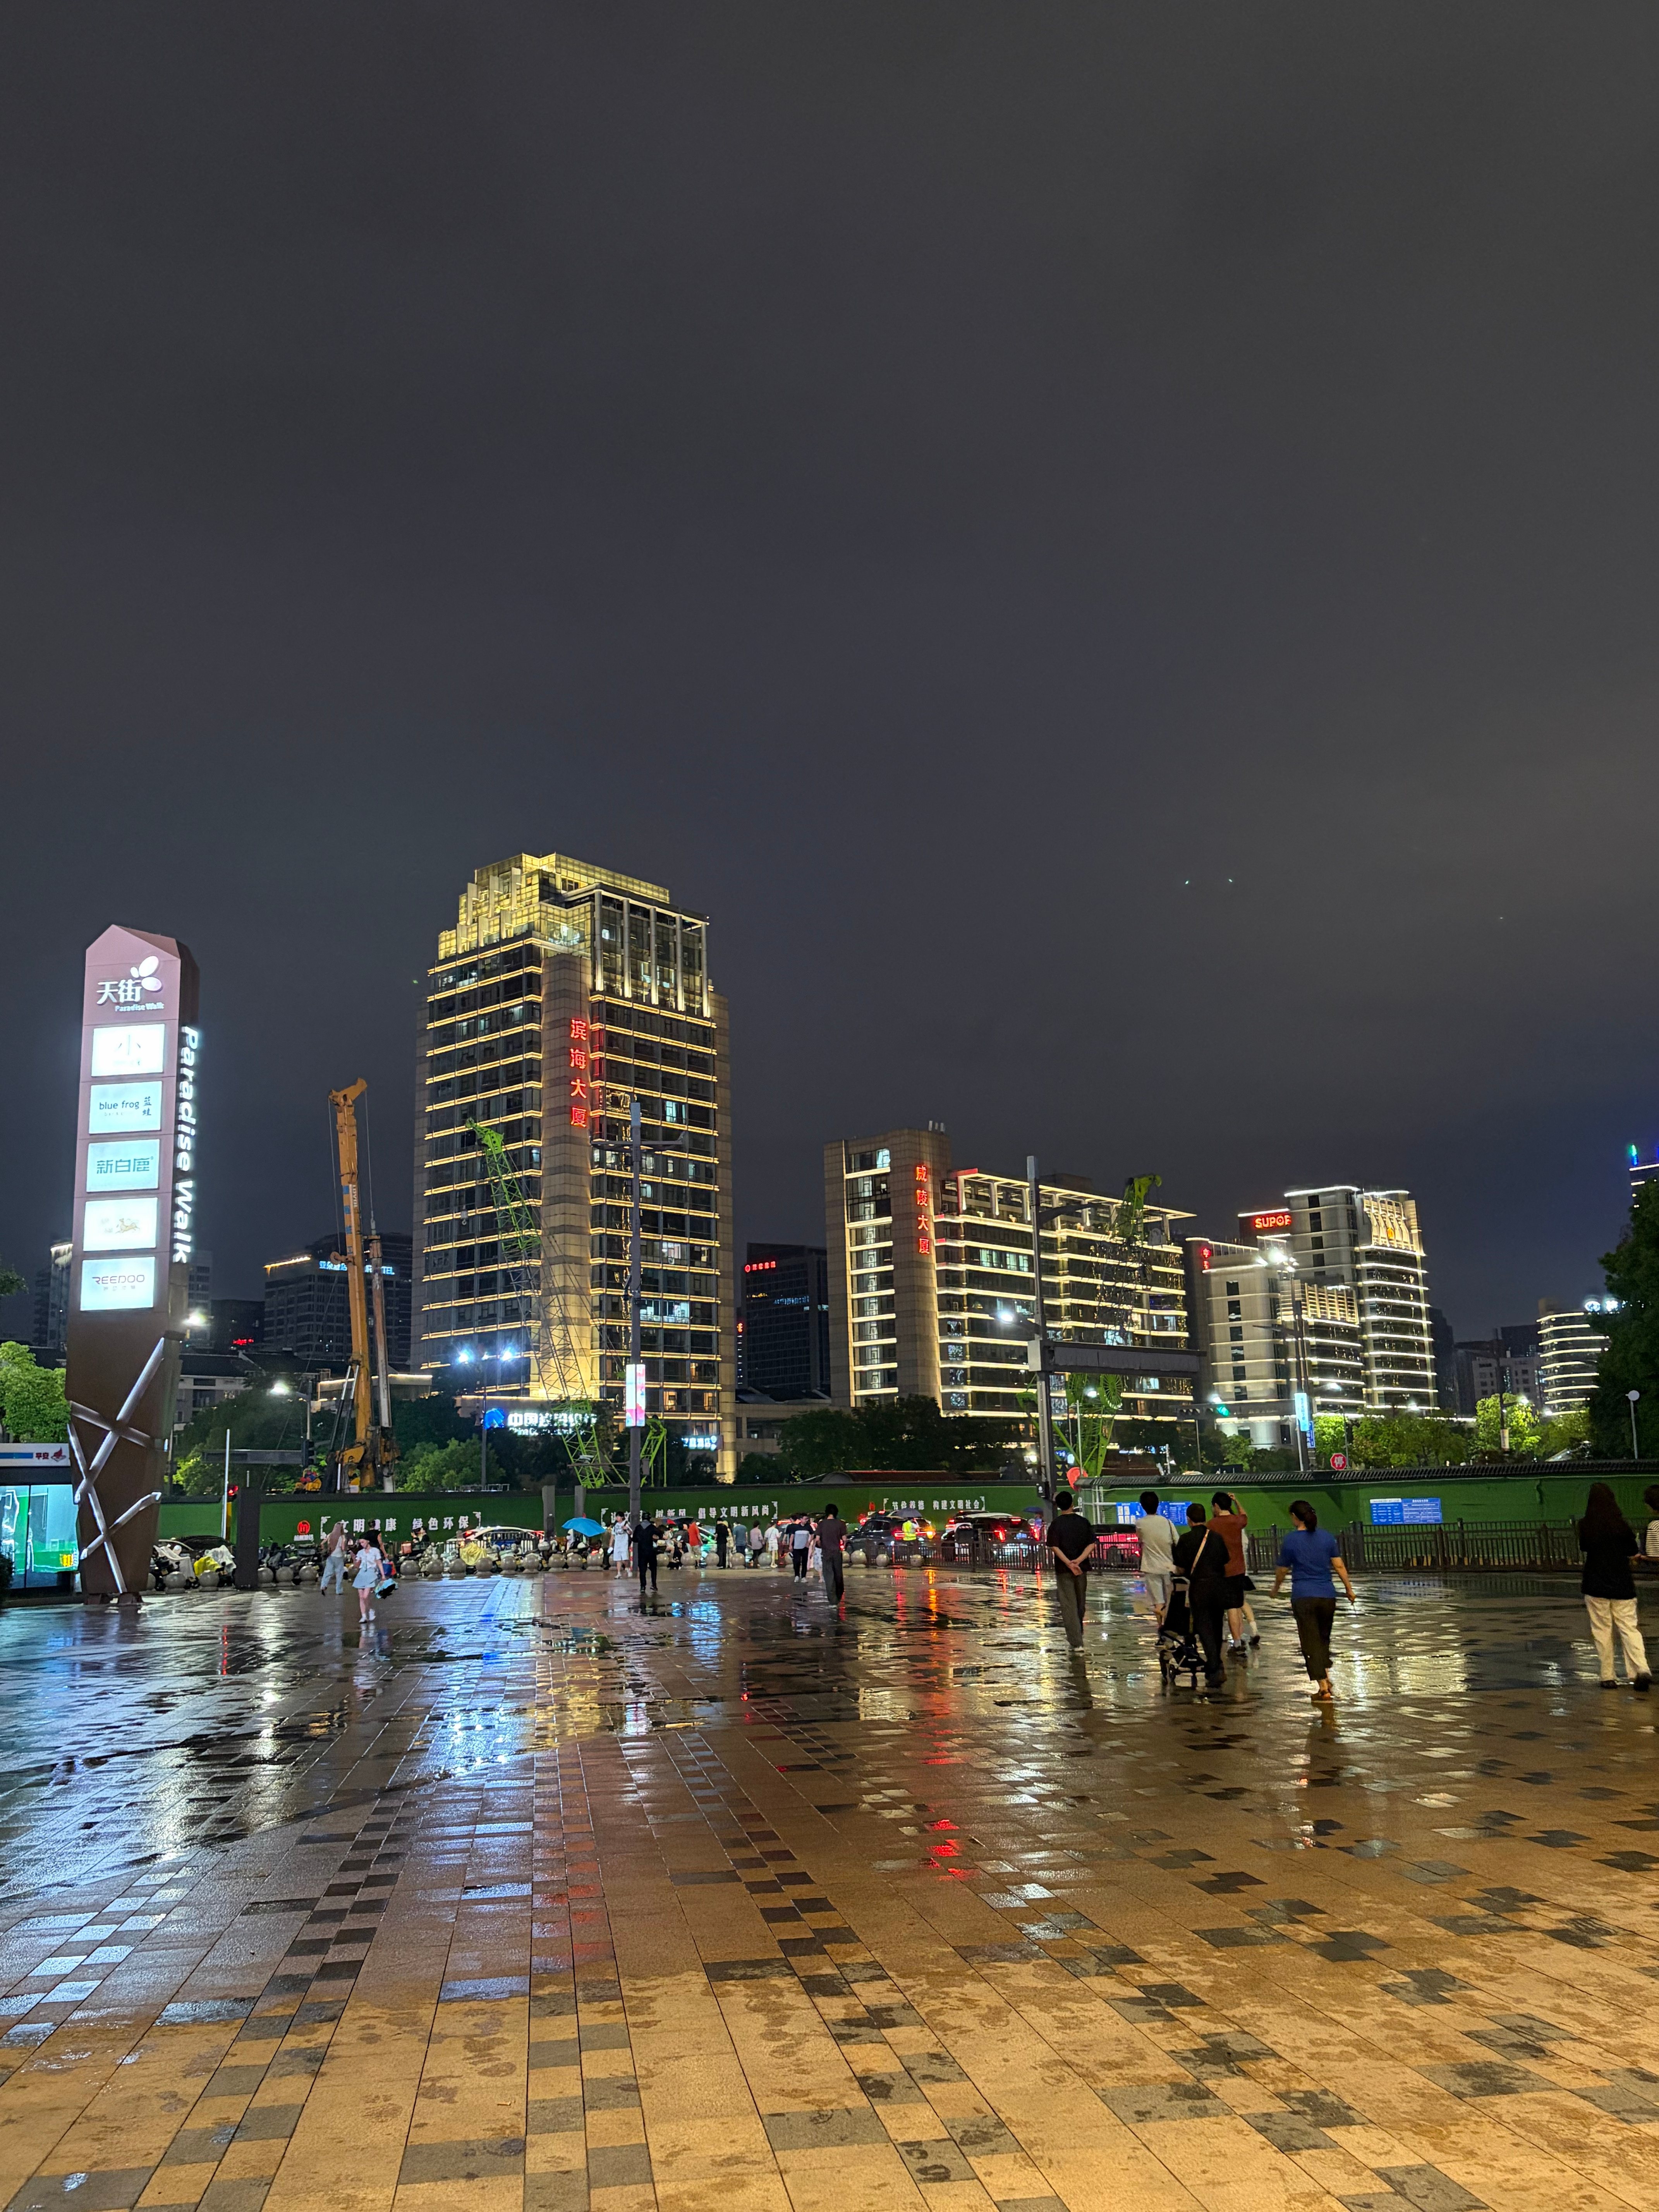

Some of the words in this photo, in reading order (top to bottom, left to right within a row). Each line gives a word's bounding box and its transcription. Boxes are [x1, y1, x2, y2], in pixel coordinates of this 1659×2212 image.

[96, 979, 142, 1004] 天街
[115, 1004, 145, 1012] Paradise
[146, 1002, 165, 1010] Walk
[570, 1019, 587, 1127] 滨海大厦
[99, 1102, 118, 1110] blue
[122, 1101, 139, 1109] frog
[142, 1096, 152, 1116] 蓝蛙
[177, 1026, 198, 1171] Paradise
[96, 1158, 150, 1174] 新白鹿
[173, 1180, 194, 1264] Walk
[698, 1504, 769, 1519] 倡导文明新风尚
